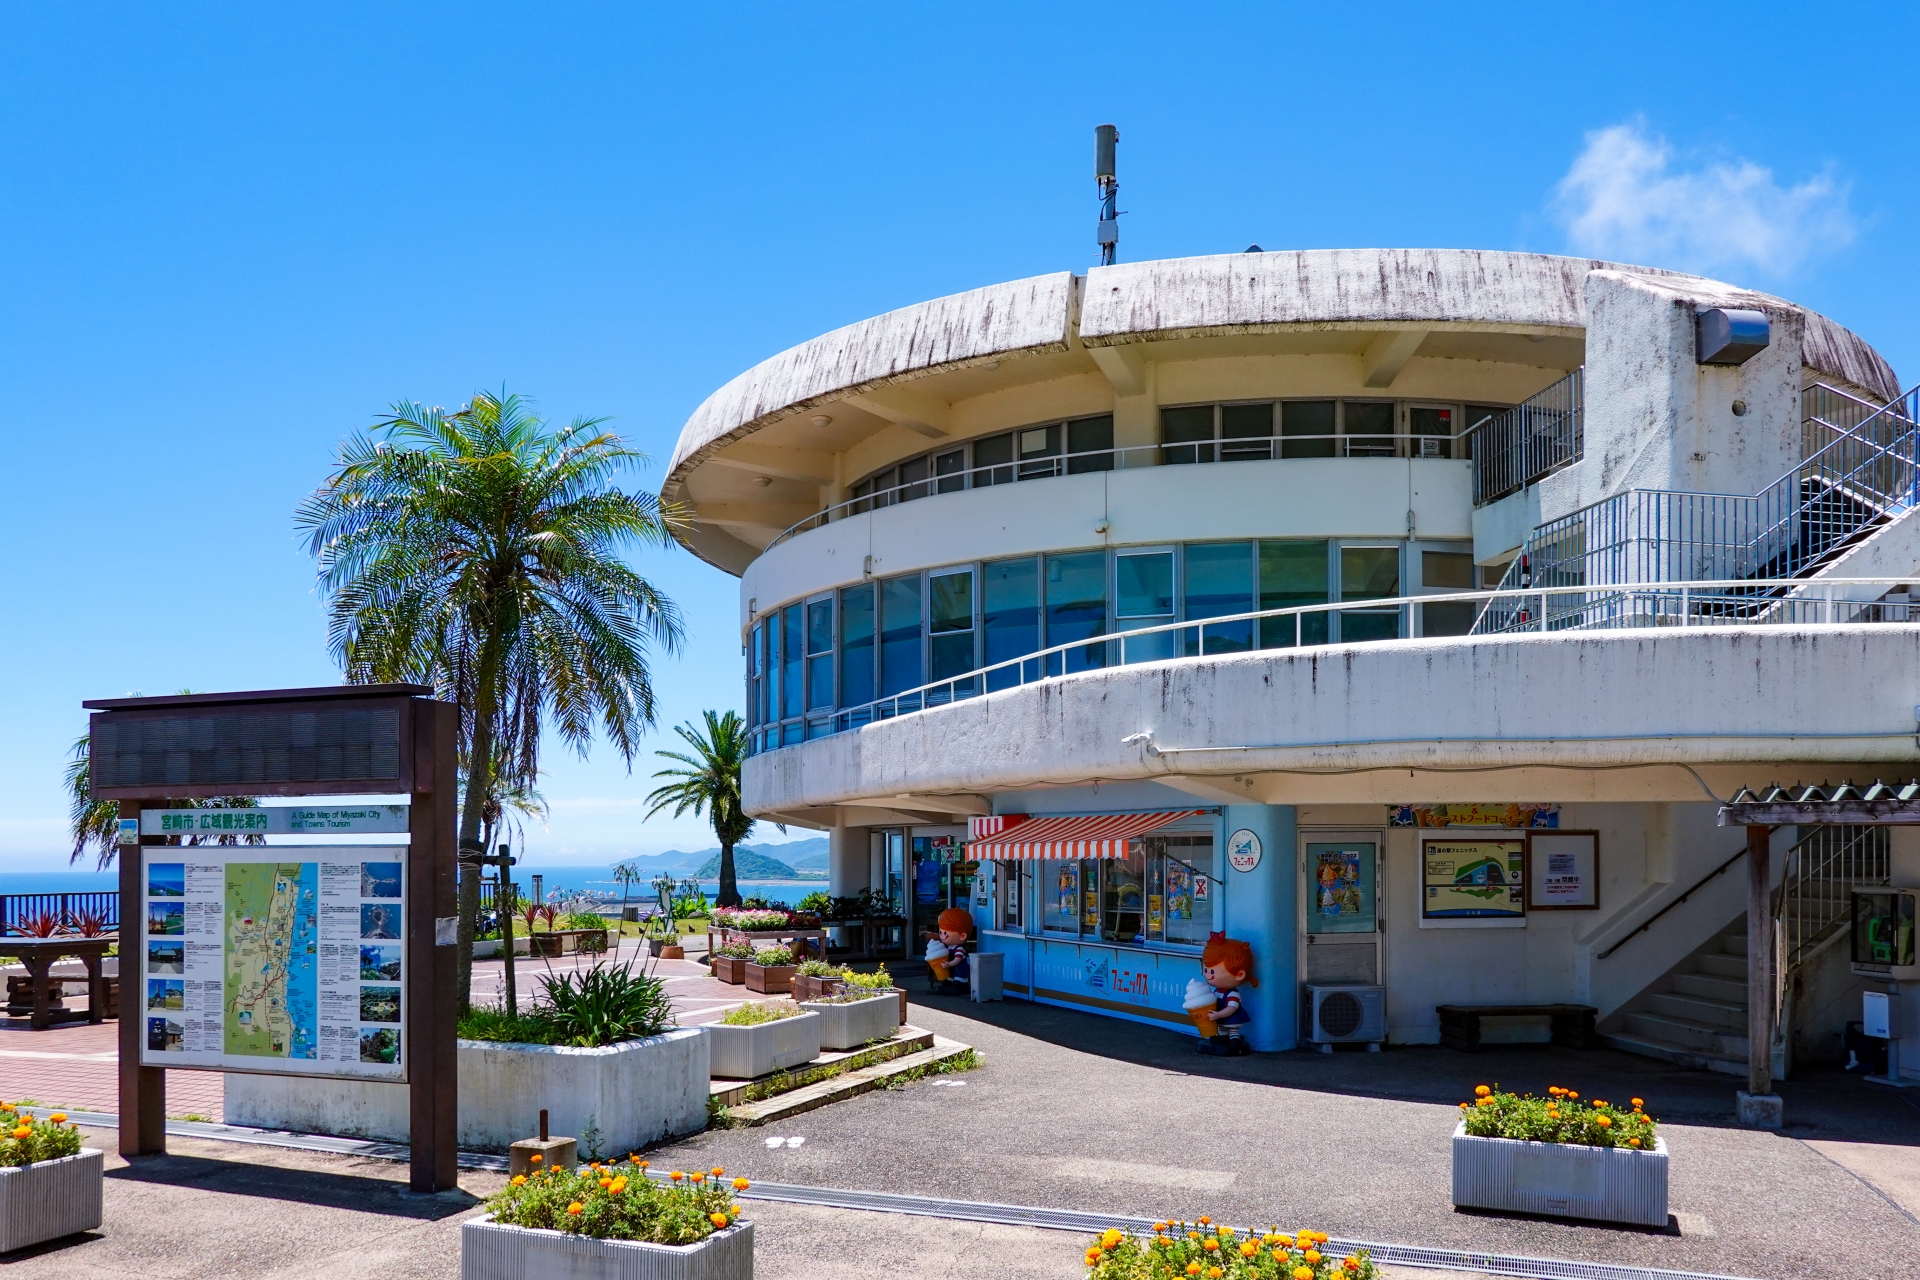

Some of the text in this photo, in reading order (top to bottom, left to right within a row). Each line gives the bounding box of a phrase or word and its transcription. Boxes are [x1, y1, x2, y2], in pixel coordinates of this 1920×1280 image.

[161, 813, 268, 830] 宮崎市・広域観光案内
[317, 811, 330, 820] Map
[340, 810, 366, 820] Miyazaki
[368, 810, 381, 820] City
[1426, 814, 1522, 823] ファーストフードコーナー
[1234, 857, 1254, 865] フェニックス
[1112, 969, 1149, 996] フェニックス
[1152, 980, 1184, 998] PARADI
